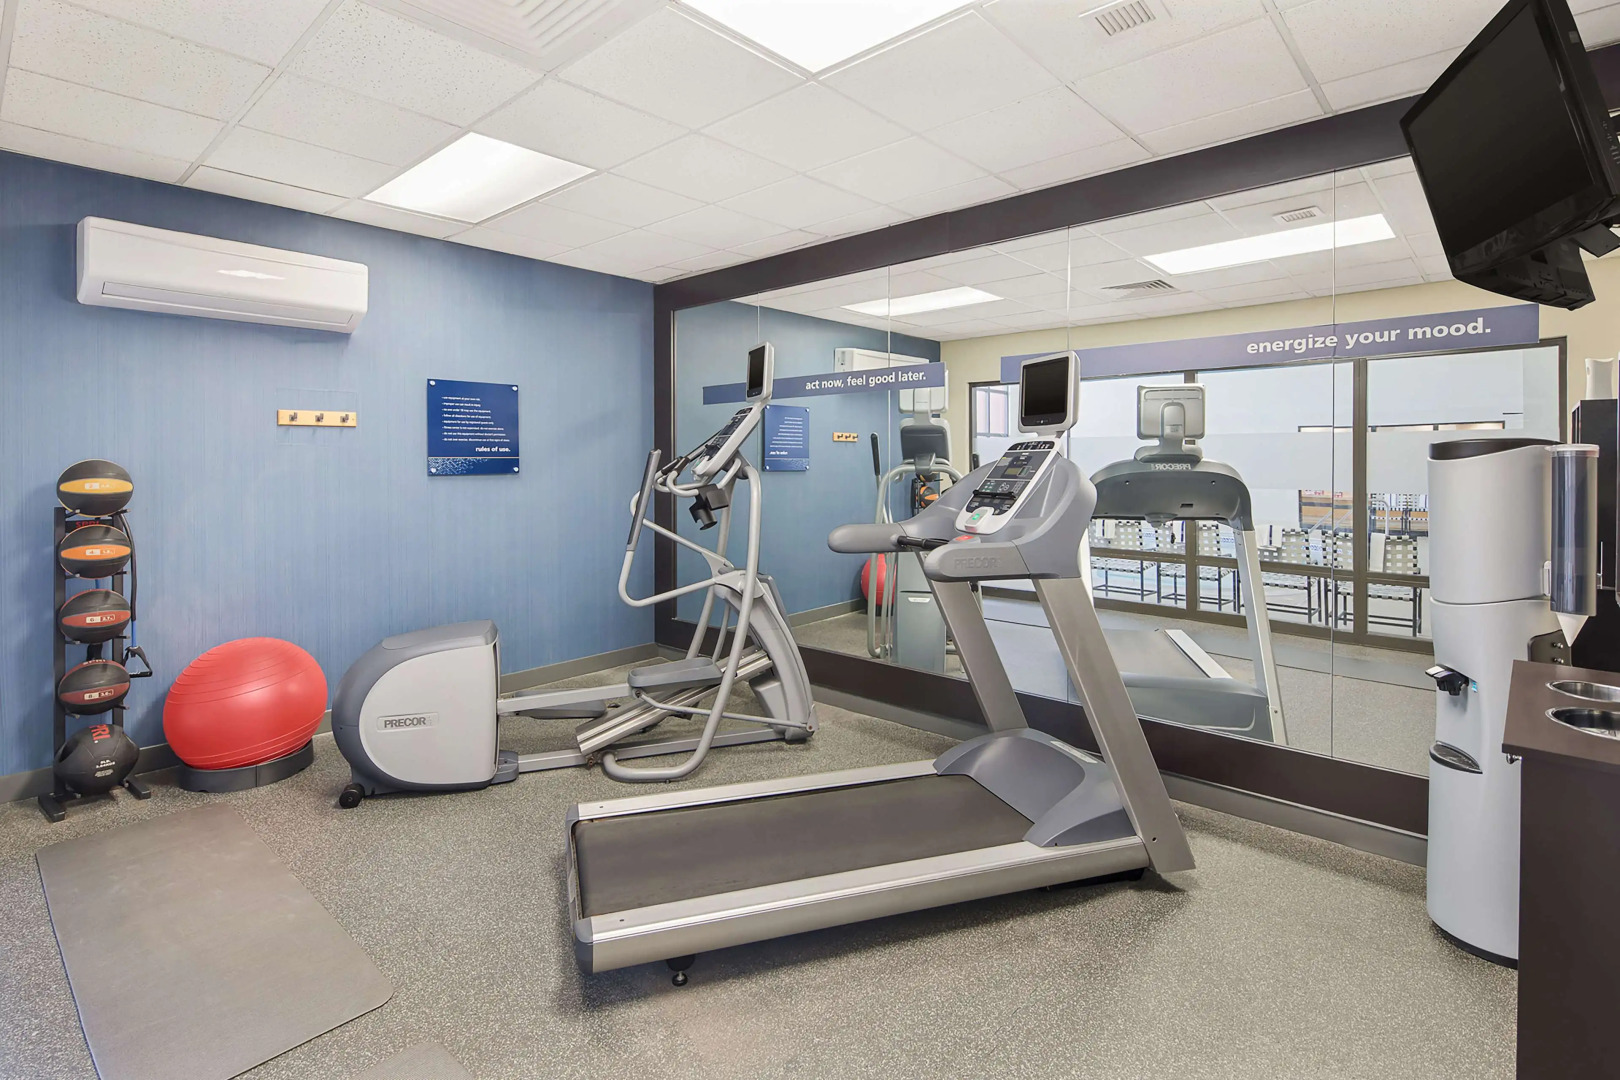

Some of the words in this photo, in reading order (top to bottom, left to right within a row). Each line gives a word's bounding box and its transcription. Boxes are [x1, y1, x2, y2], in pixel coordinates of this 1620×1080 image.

[1247, 334, 1338, 353] energize
[1345, 329, 1400, 349] your
[1408, 317, 1491, 340] mood.
[805, 380, 820, 390] act
[821, 378, 844, 388] now,
[847, 375, 866, 386] feel
[868, 372, 895, 387] good
[898, 371, 927, 382] later.
[954, 556, 998, 569] PRECOR
[384, 716, 426, 728] PRECOR
